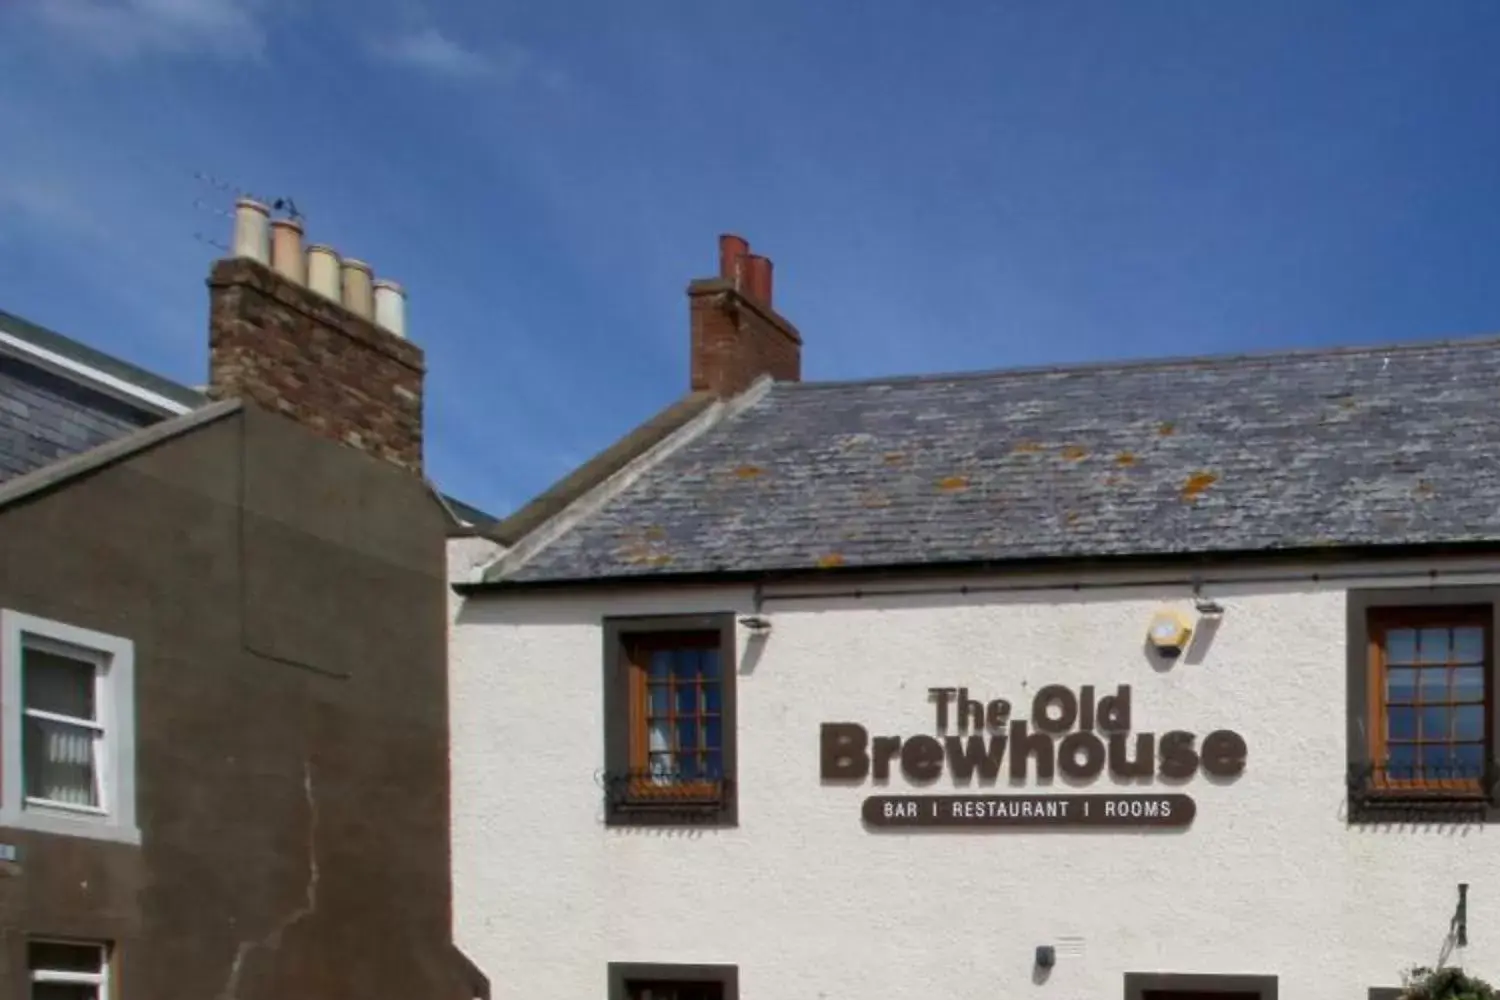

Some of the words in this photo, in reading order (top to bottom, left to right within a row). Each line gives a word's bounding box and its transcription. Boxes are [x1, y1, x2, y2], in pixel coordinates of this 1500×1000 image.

[928, 687, 1011, 734] The
[1031, 684, 1131, 733] Old
[820, 721, 1248, 785] Brewhouse
[884, 802, 917, 817] BAR
[952, 802, 1069, 818] RESTAURANT
[1105, 802, 1172, 817] ROOMS
